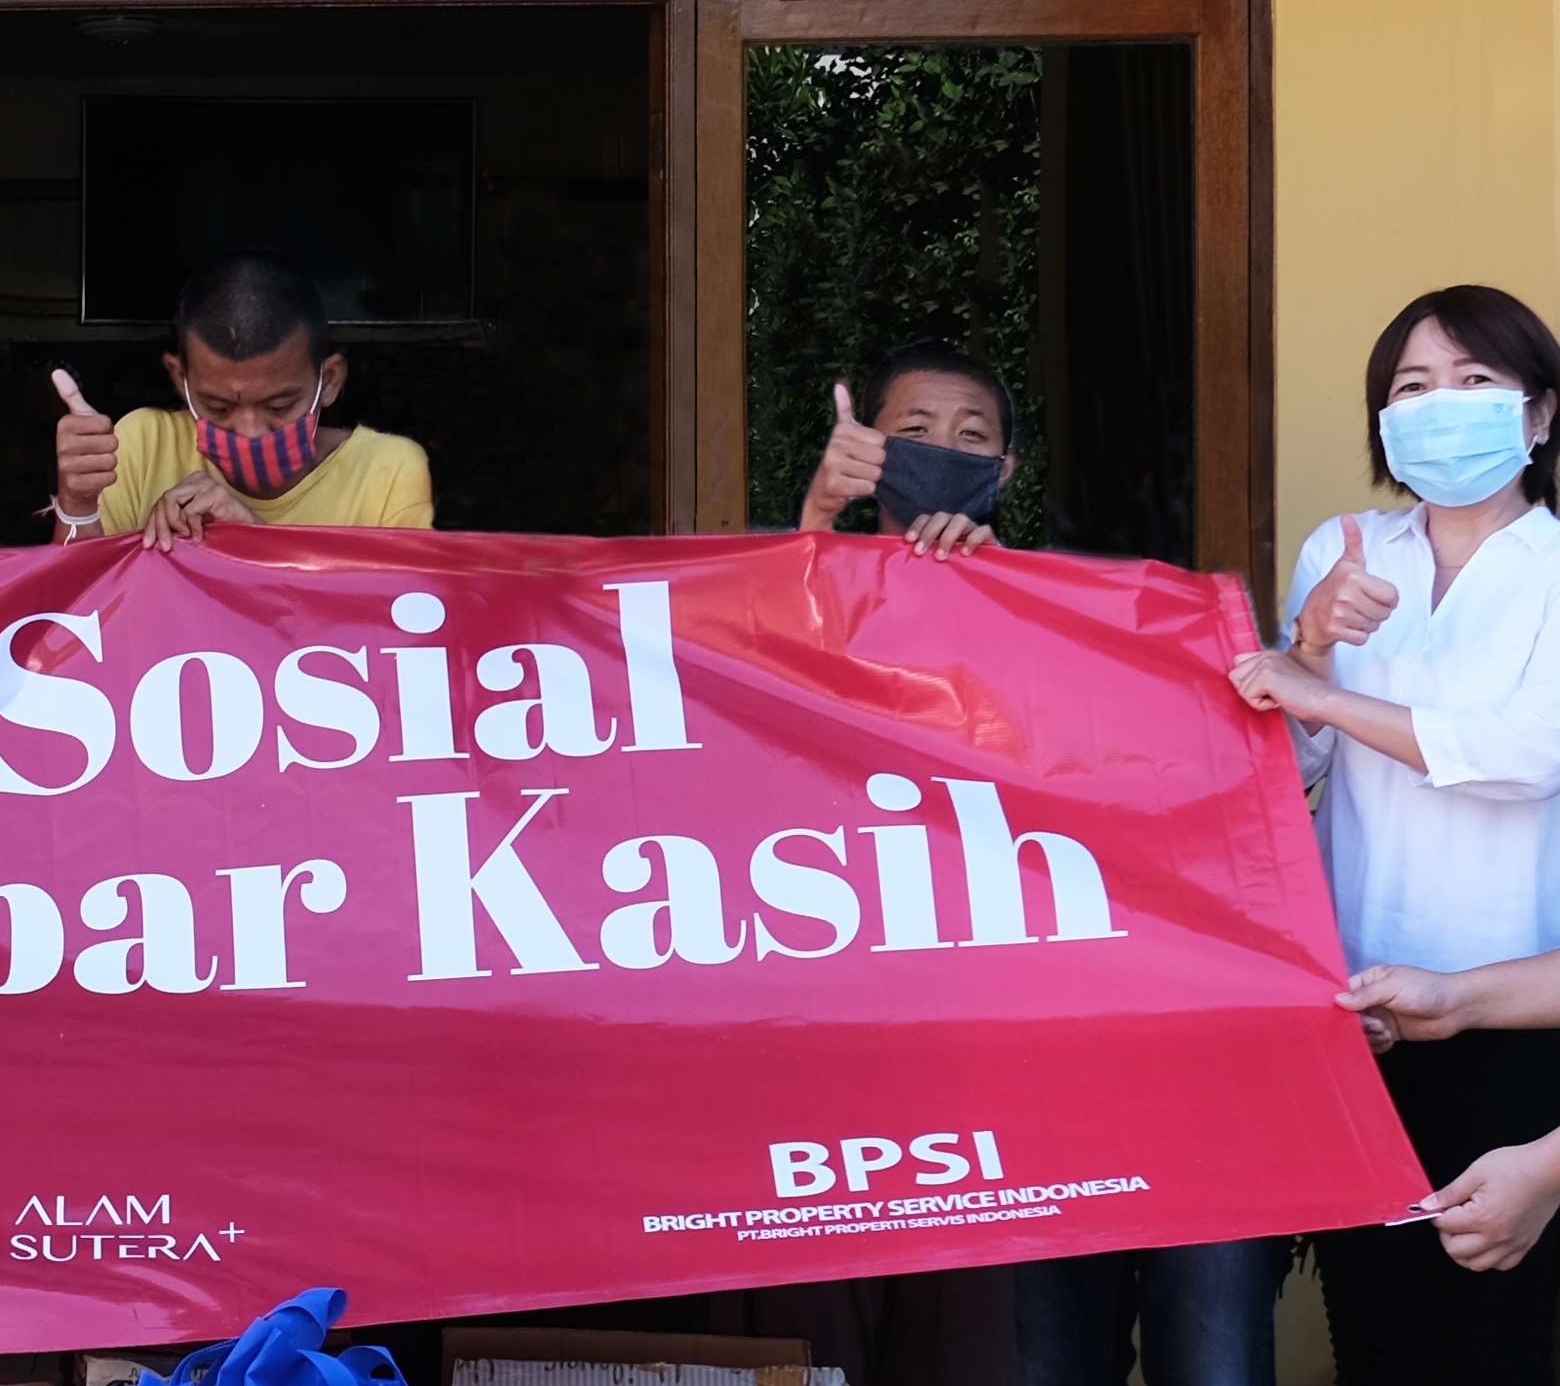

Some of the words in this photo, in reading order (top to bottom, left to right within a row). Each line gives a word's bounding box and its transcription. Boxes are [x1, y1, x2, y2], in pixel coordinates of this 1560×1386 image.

[397, 774, 1128, 983] Kasih
[769, 1130, 1004, 1198] BPSI
[15, 1195, 170, 1226] ALAM
[643, 1211, 741, 1233] BRIGHT
[746, 1202, 884, 1226] PROPERTY
[888, 1192, 995, 1216] SERVICE
[999, 1176, 1149, 1208] INDONESIA
[826, 1220, 906, 1235] PROPERTI
[909, 1214, 966, 1229] SERVIS
[969, 1206, 1061, 1223] INDONESIA
